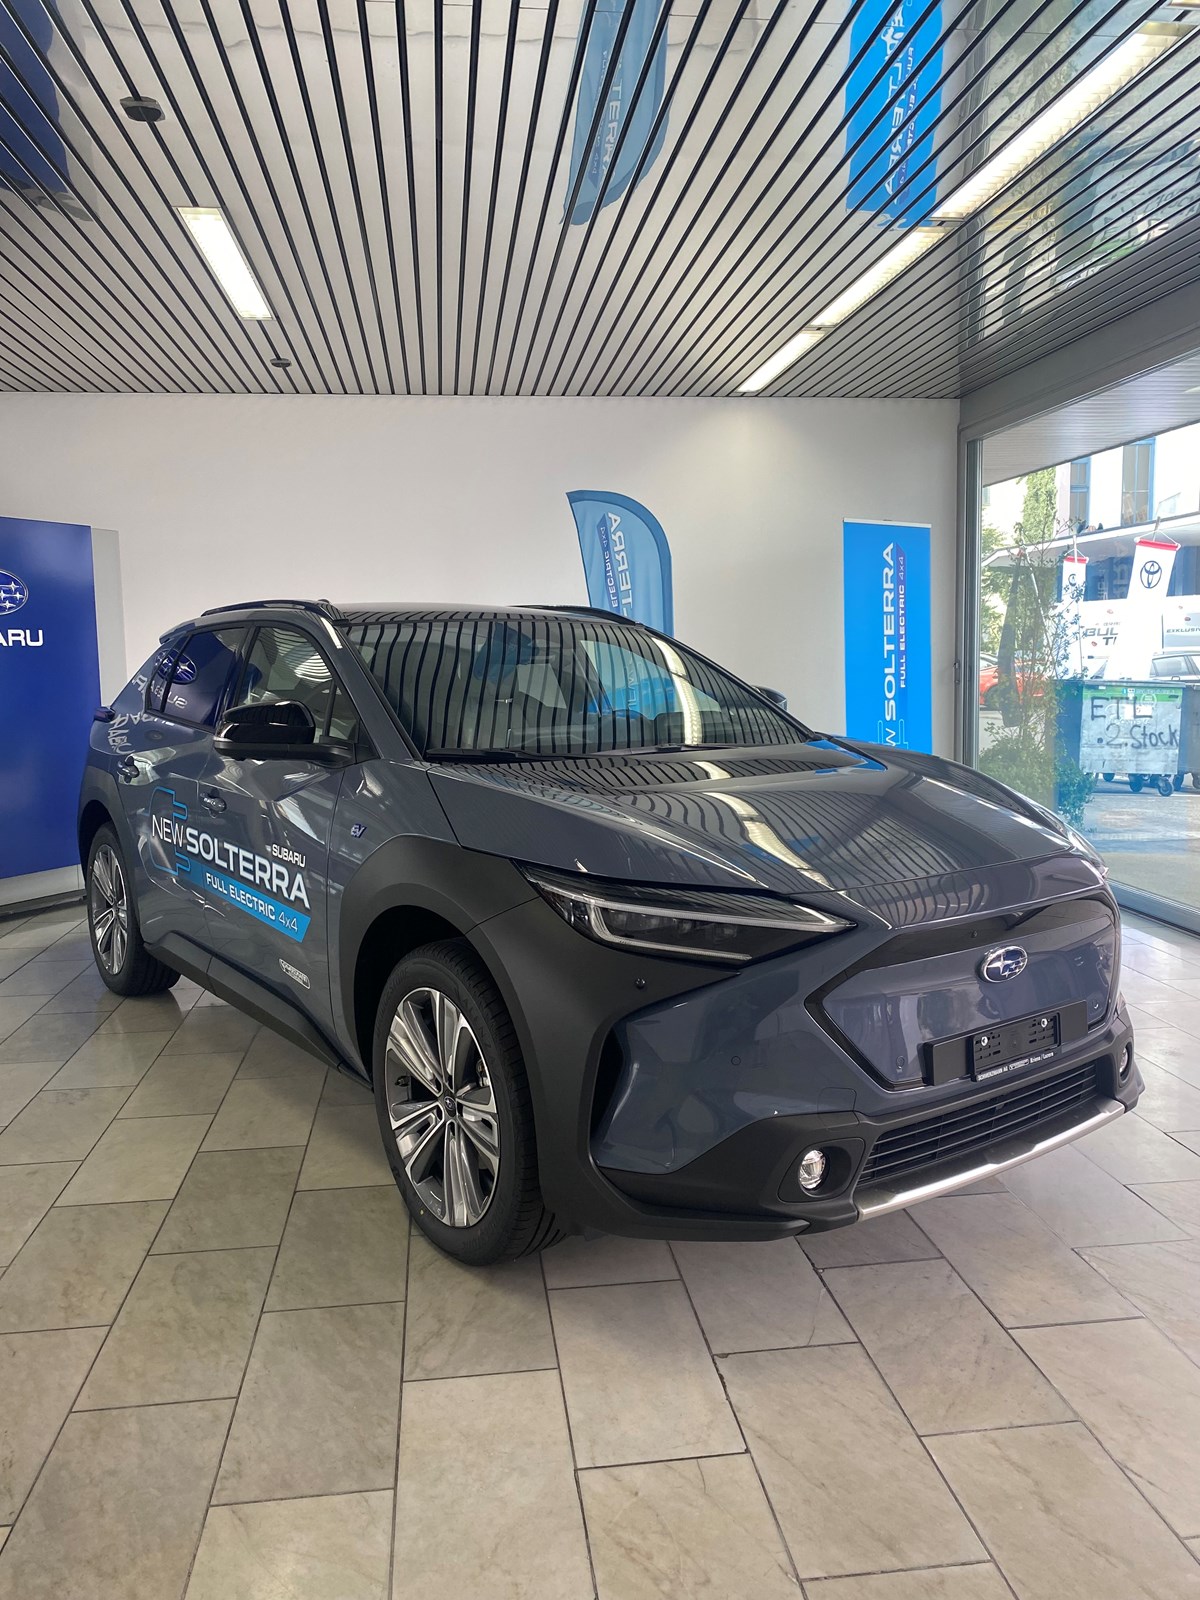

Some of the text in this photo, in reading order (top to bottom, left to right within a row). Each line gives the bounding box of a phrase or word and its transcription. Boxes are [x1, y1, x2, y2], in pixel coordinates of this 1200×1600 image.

[883, 542, 896, 721] SOLTERRA
[152, 814, 311, 910] NEW SOLTERRA
[272, 843, 306, 868] SUBARU
[206, 872, 298, 932] FULL ELECTRIC 4x4
